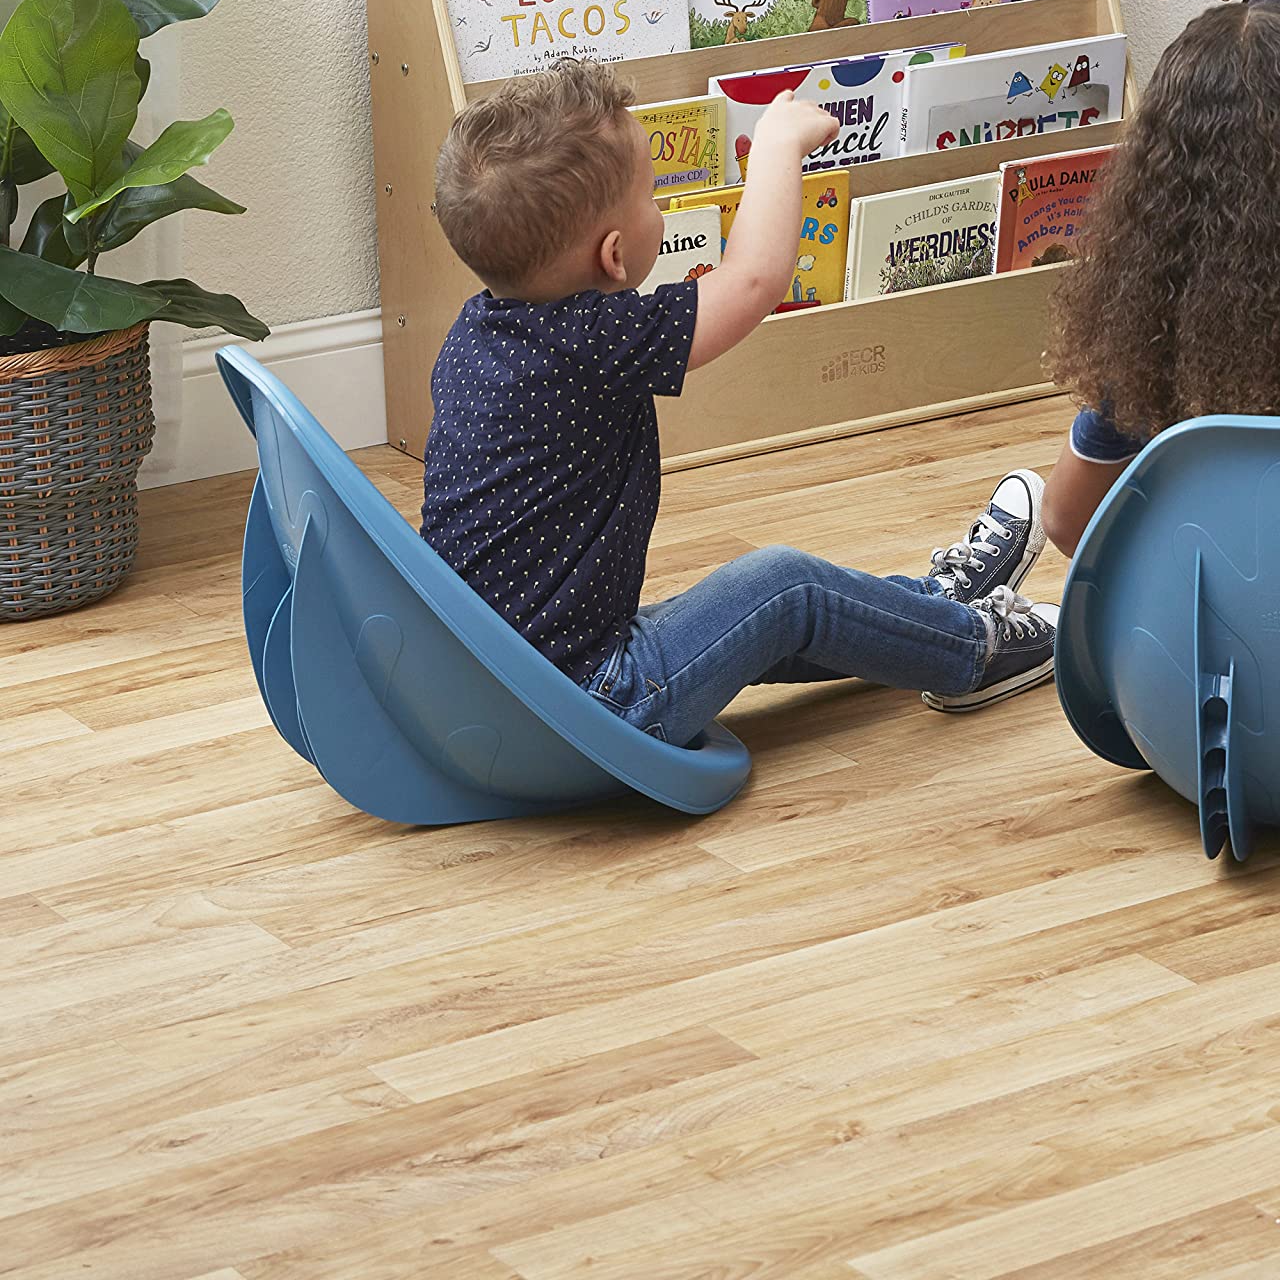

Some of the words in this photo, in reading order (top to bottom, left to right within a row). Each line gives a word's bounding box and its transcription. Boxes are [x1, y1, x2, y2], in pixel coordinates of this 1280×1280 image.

[543, 49, 569, 59] Adam
[572, 45, 598, 56] Rubin
[671, 174, 685, 184] the
[687, 170, 703, 181] CD!
[928, 192, 944, 201] DICK
[944, 188, 970, 198] GAUTIER
[894, 224, 903, 235] A
[904, 204, 949, 227] CHILD'S
[951, 200, 998, 214] GARDEN
[1023, 202, 1057, 225] Orange
[1058, 196, 1074, 206] You
[942, 216, 953, 225] OF
[1017, 224, 1064, 253] Amber
[850, 344, 886, 366] ECR
